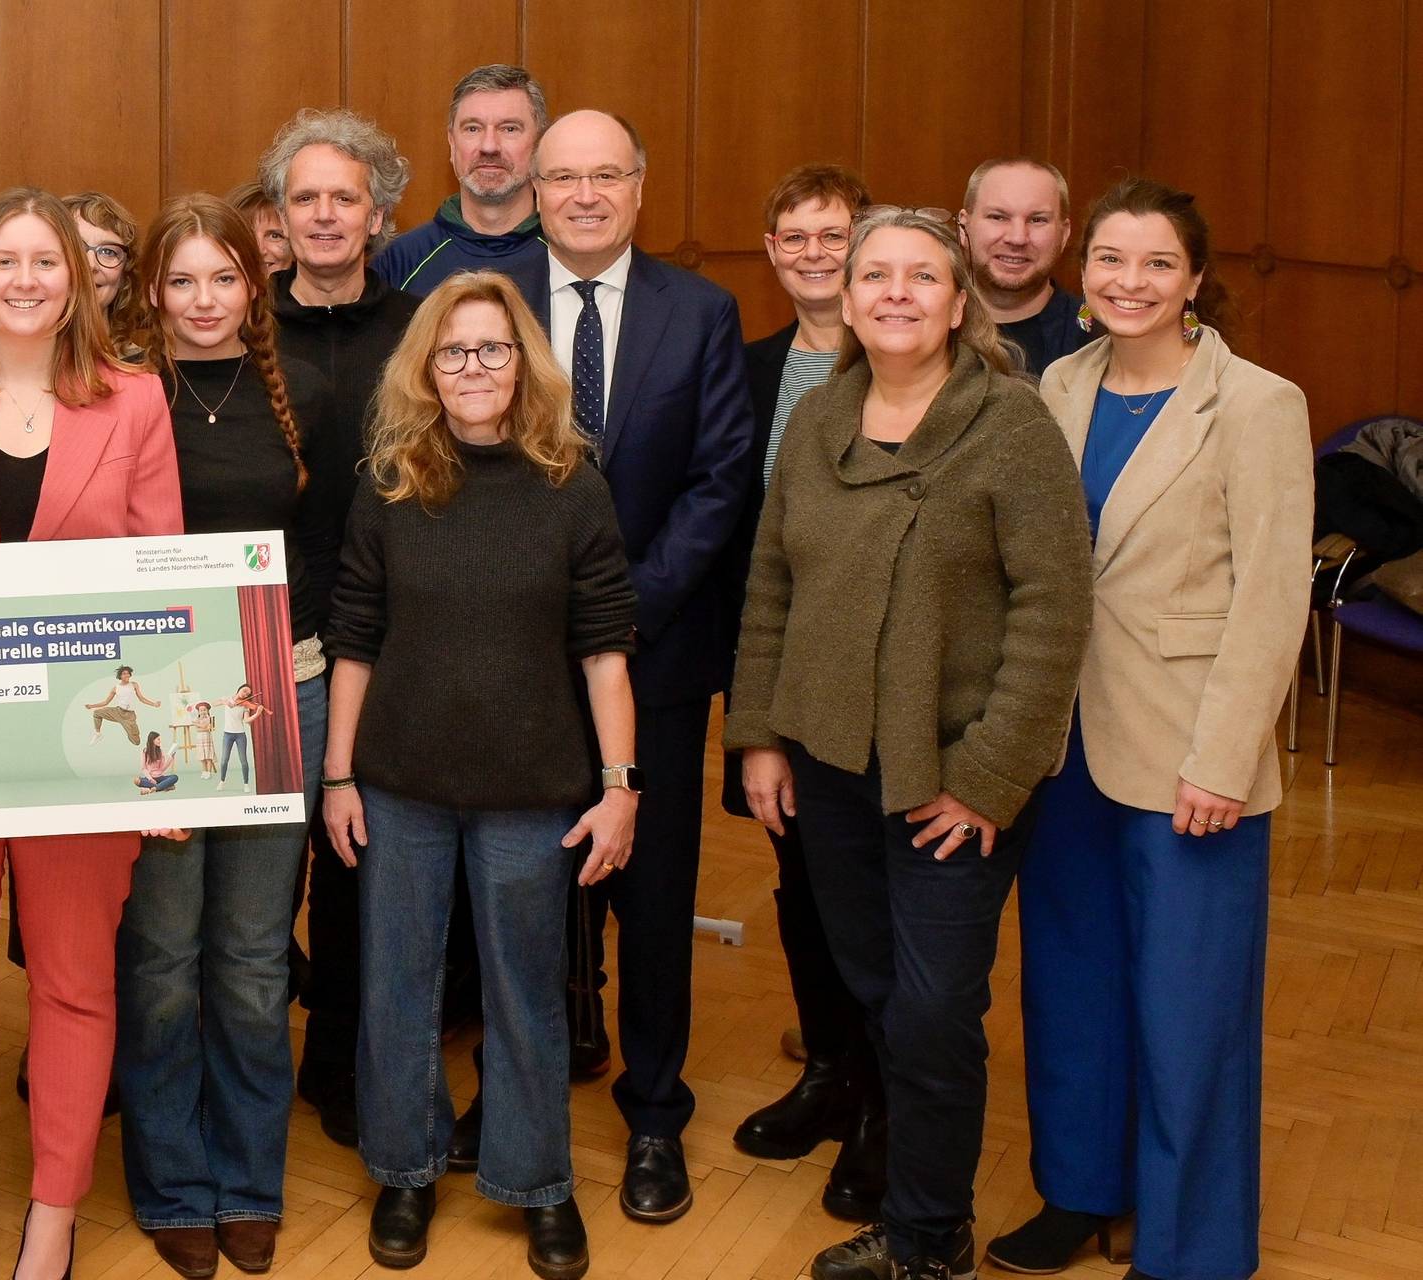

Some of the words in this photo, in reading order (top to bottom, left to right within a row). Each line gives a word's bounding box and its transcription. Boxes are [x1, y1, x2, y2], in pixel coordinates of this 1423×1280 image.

[135, 548, 171, 556] Ministerium
[171, 562, 234, 571] Nordrhein-Westfalen
[33, 615, 186, 636] Gesamtkonzepte
[47, 641, 116, 658] Bildung
[13, 684, 42, 696] 2025
[244, 805, 290, 814] mkw.nrw
